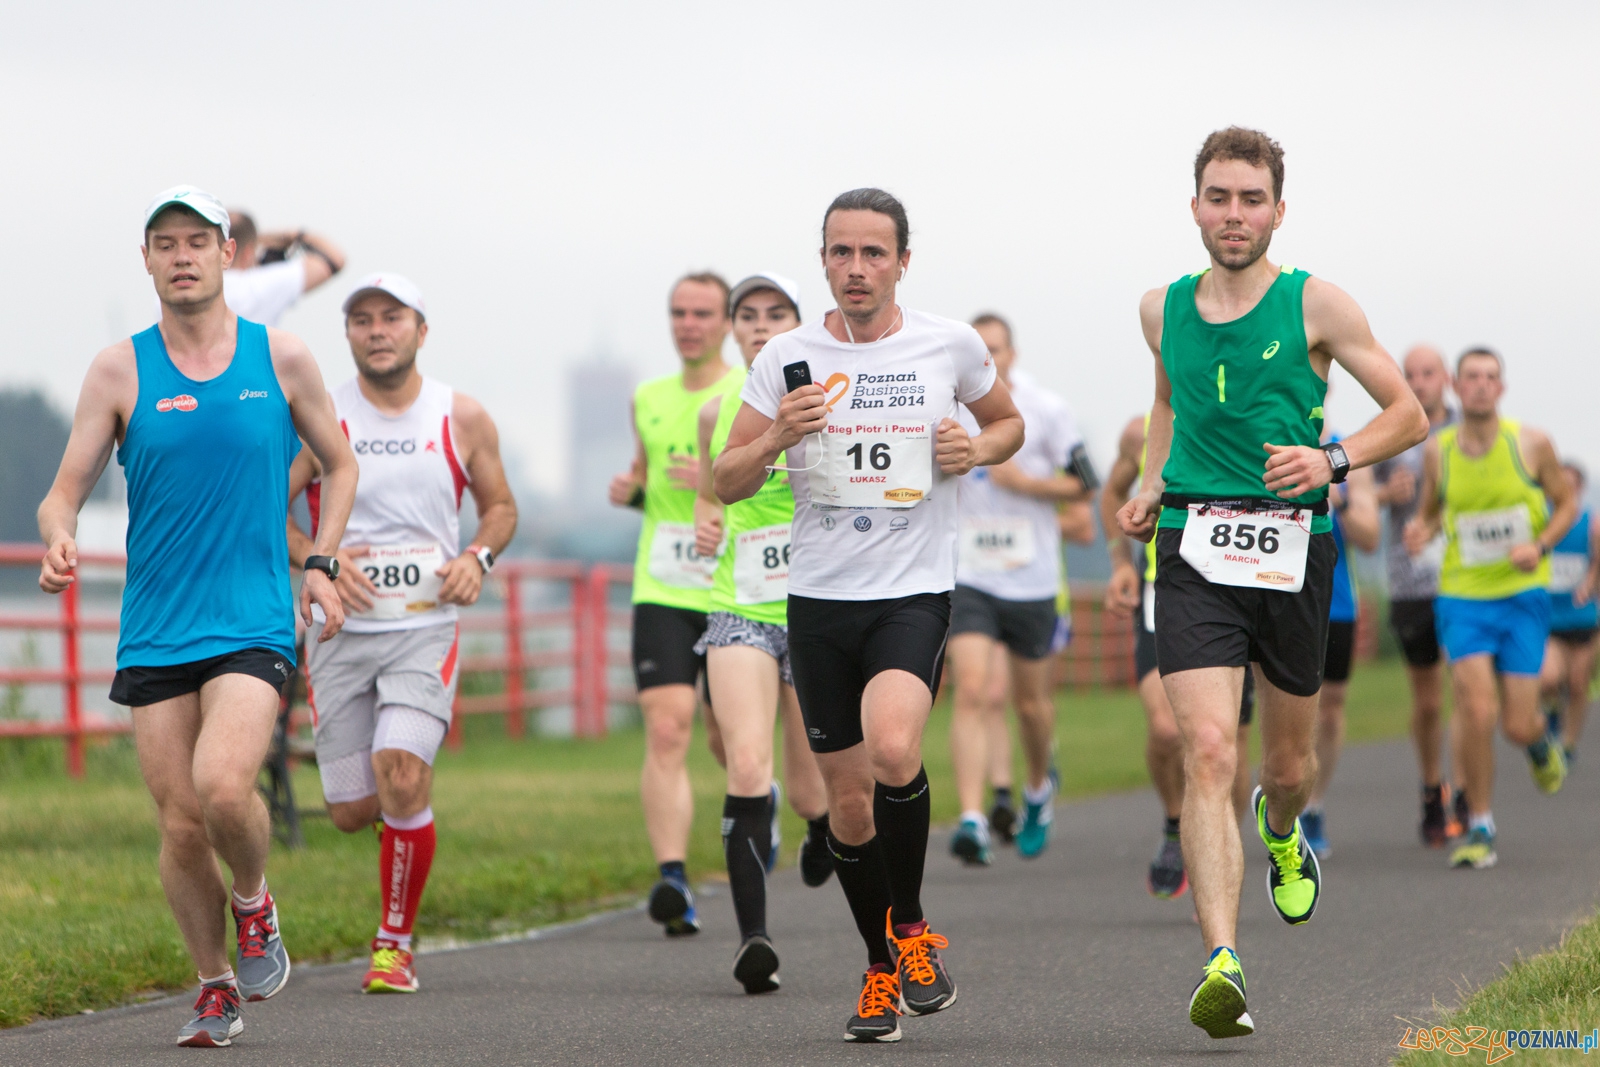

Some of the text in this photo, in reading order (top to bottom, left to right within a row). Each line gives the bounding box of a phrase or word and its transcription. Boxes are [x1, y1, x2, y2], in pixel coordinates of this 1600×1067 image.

[857, 371, 916, 384] Poznań
[854, 385, 925, 397] Business
[850, 395, 924, 409] Run 2014
[828, 424, 924, 435] Bieg Piotr i Paweł
[355, 439, 416, 455] ecco
[846, 443, 892, 470] 16
[1210, 524, 1280, 554] 856
[672, 540, 718, 563] 10
[1224, 554, 1260, 565] MARCIN
[363, 564, 420, 587] 280
